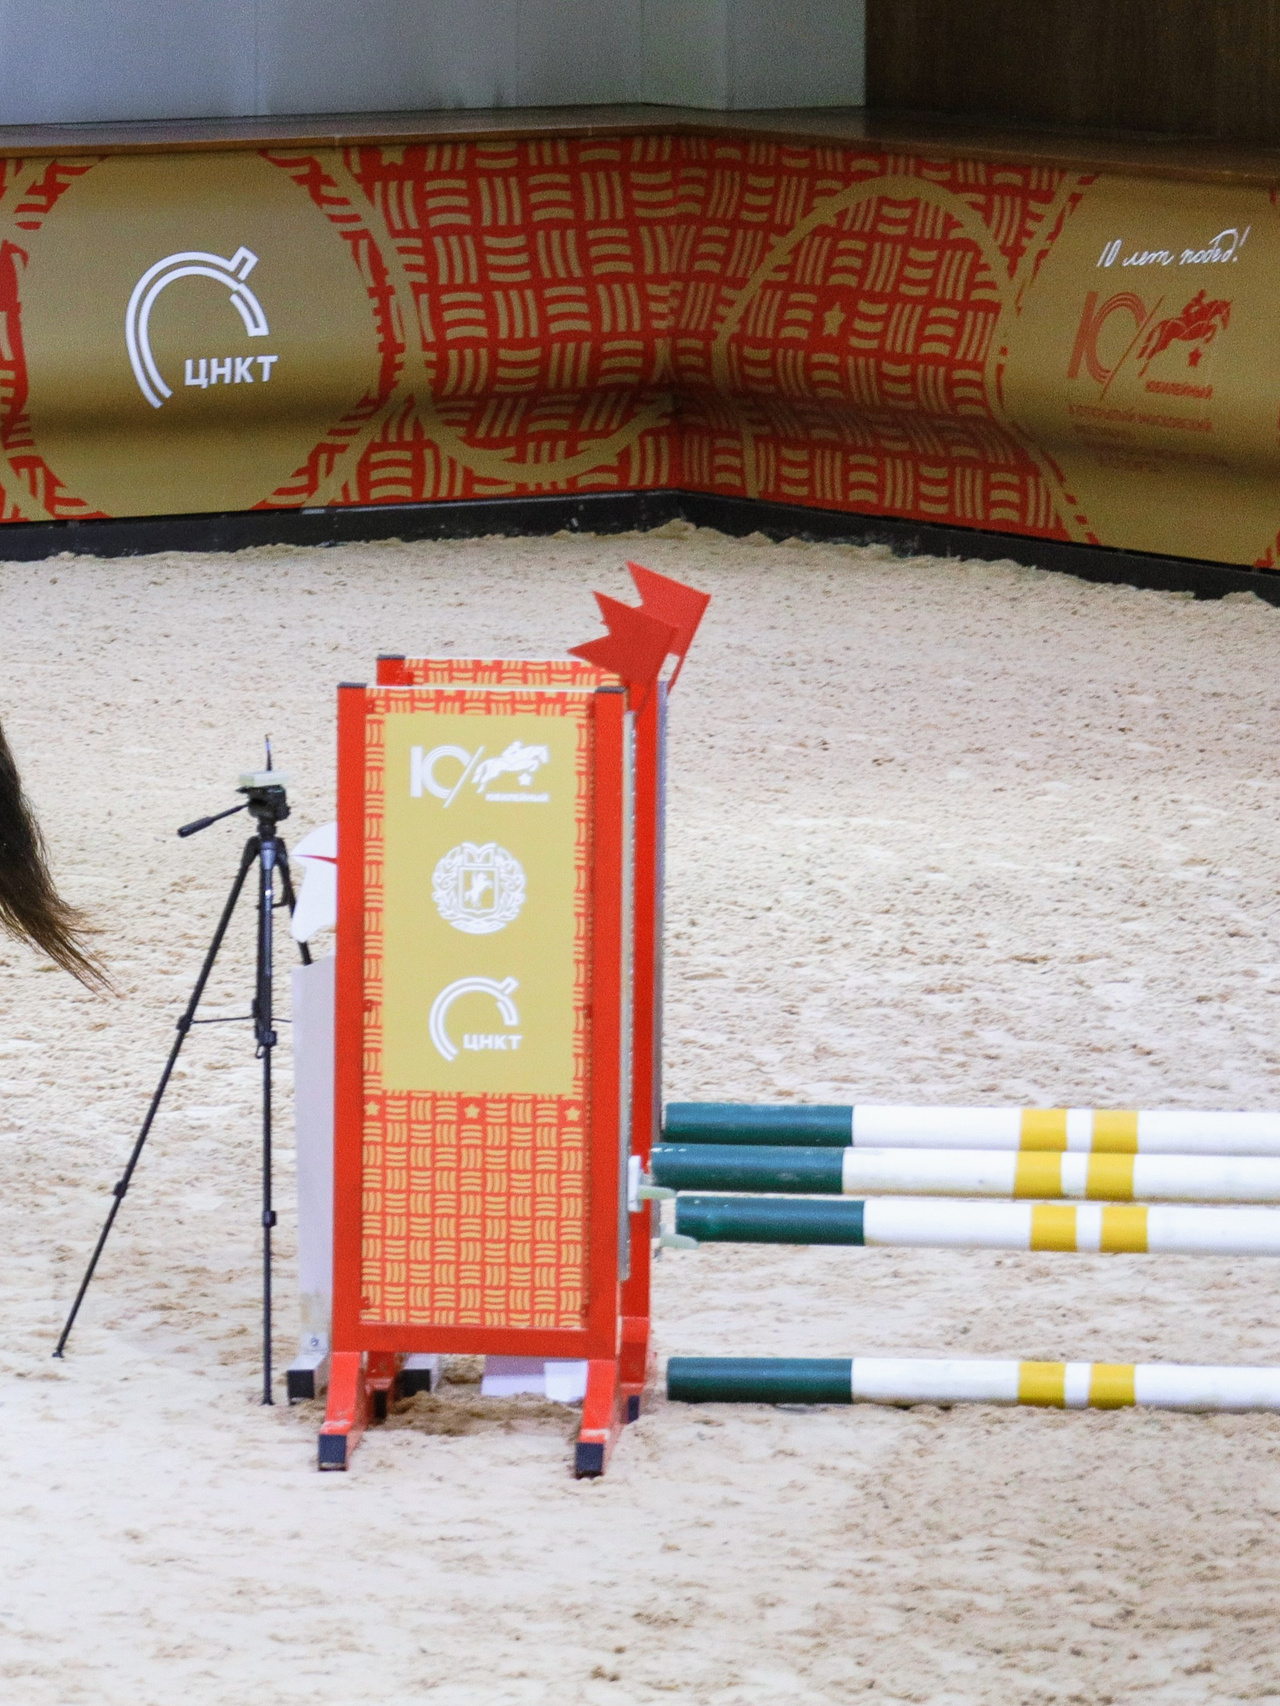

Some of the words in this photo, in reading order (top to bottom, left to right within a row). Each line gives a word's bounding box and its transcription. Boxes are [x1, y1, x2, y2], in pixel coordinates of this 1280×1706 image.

[1096, 238, 1122, 267] 10
[1122, 250, 1174, 267] лет
[184, 355, 280, 389] ЦНКТ
[462, 1033, 523, 1051] ЦНКТ
